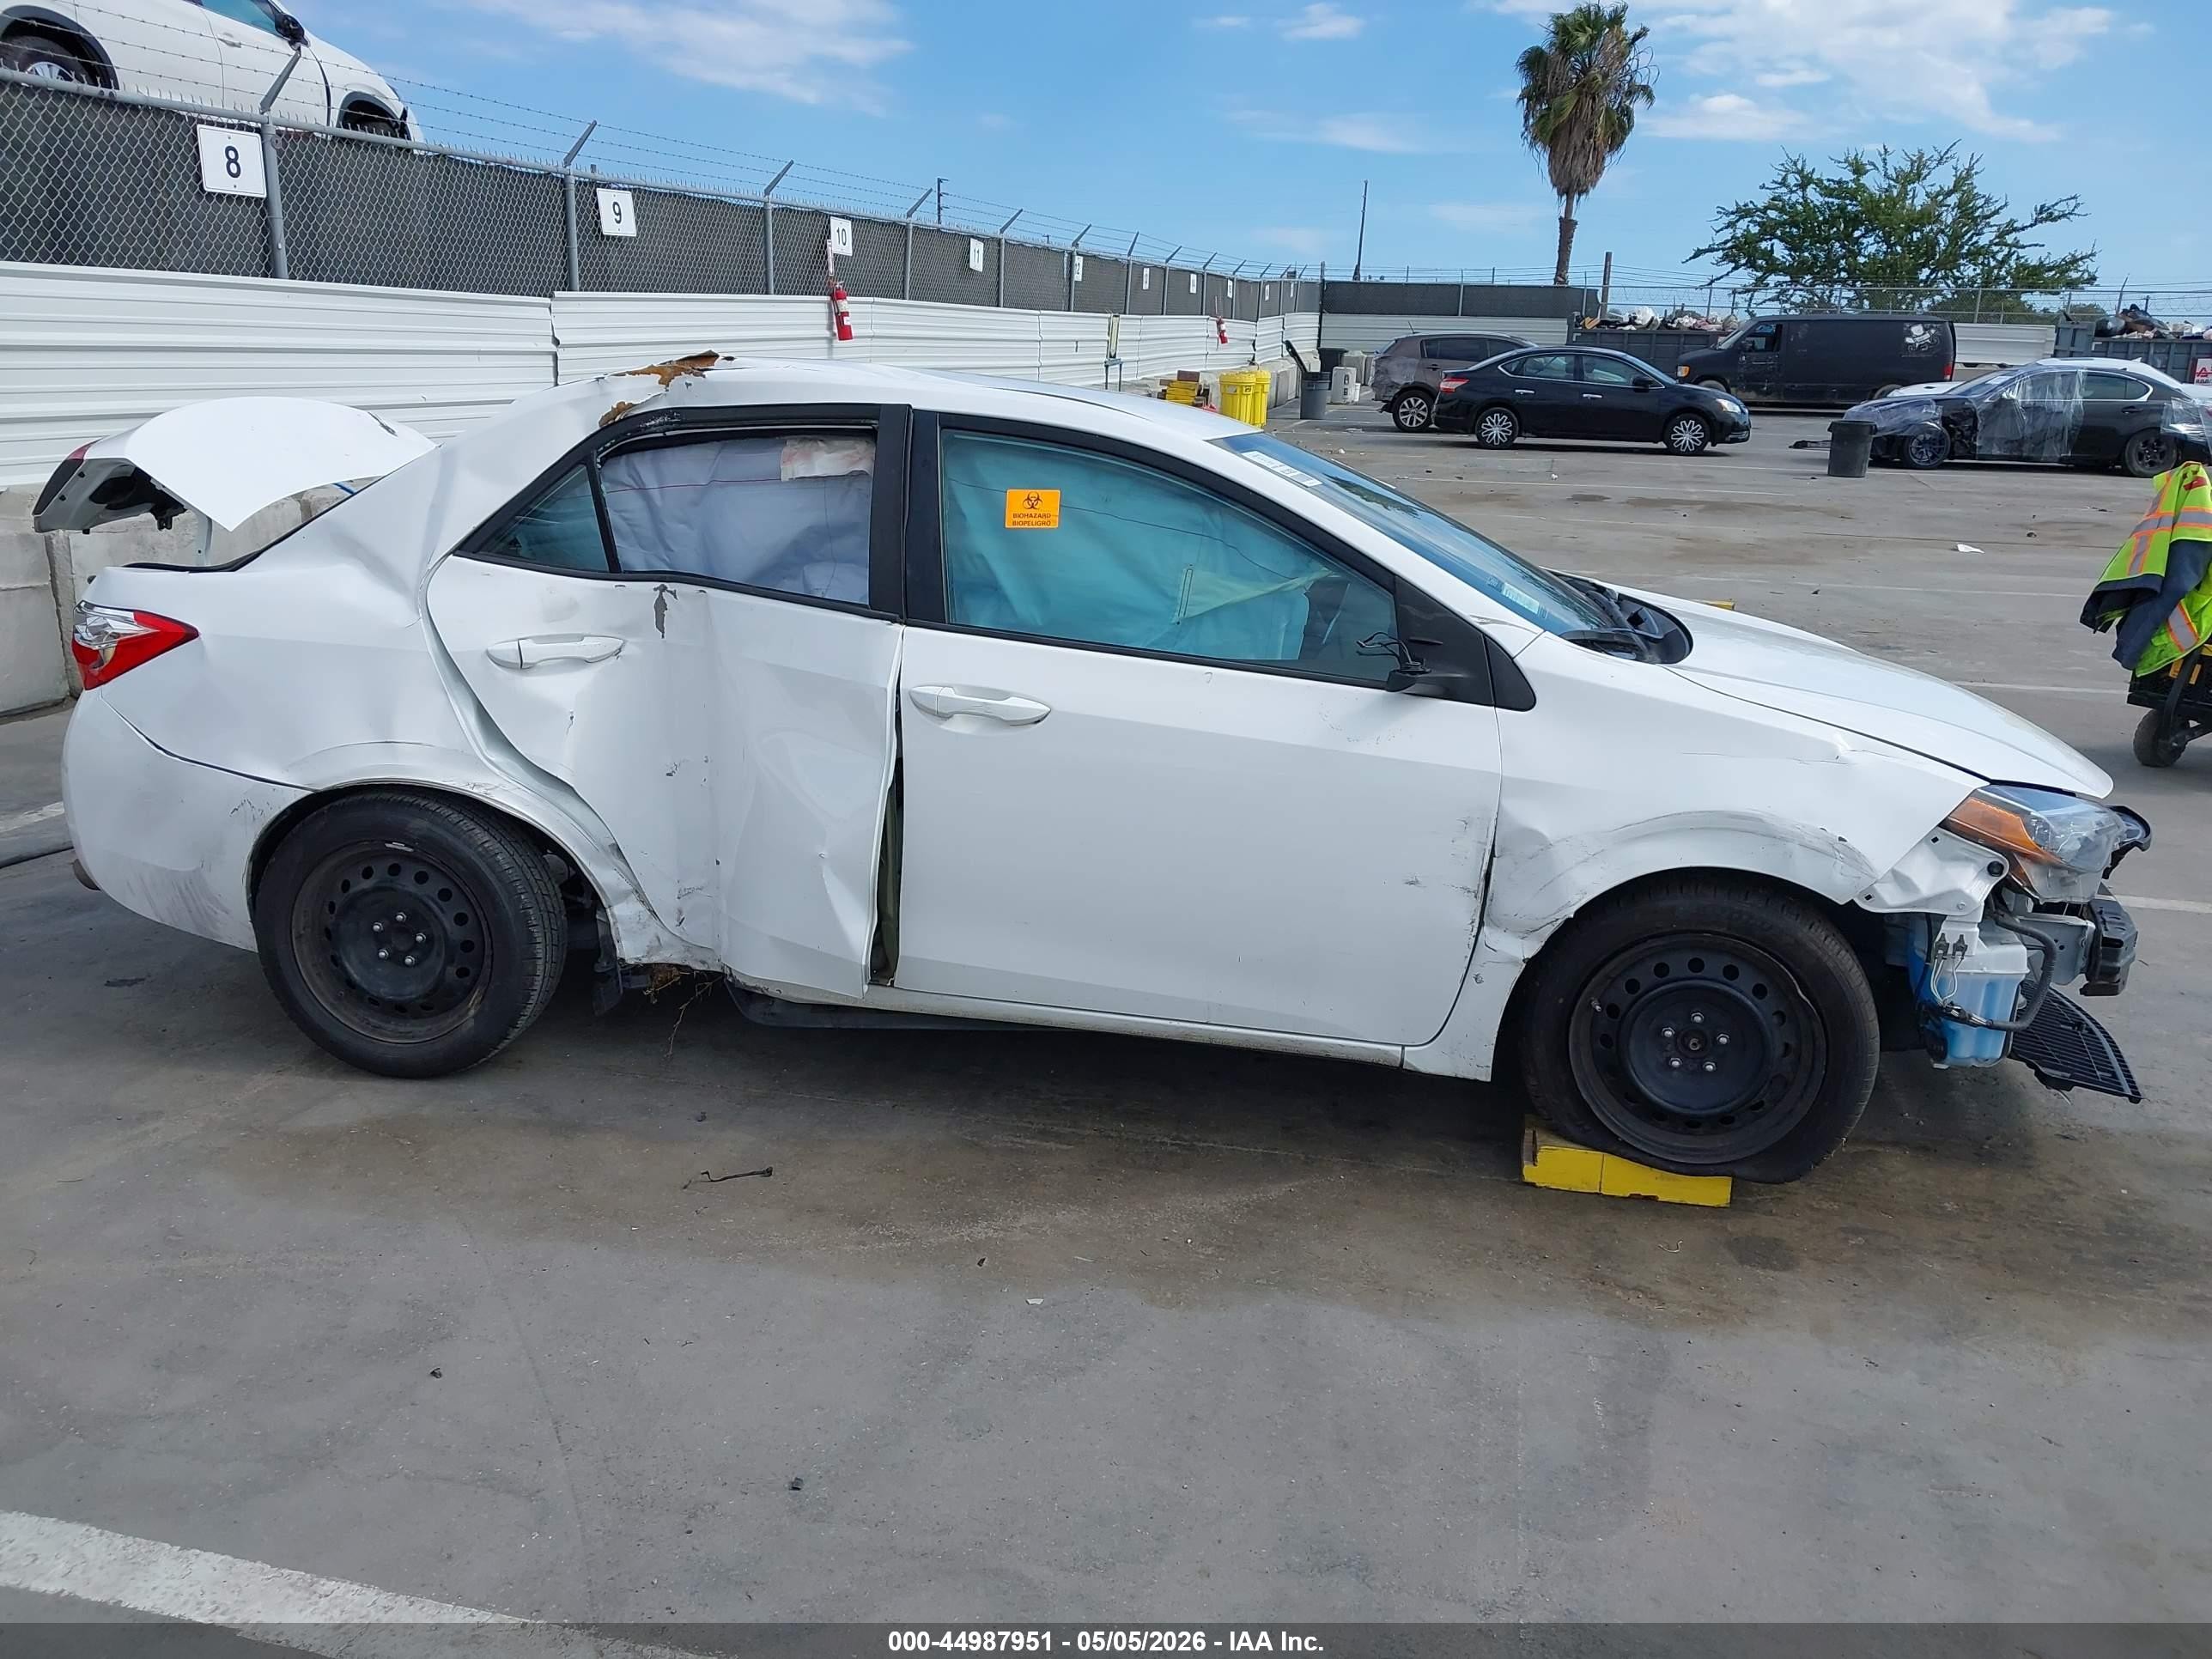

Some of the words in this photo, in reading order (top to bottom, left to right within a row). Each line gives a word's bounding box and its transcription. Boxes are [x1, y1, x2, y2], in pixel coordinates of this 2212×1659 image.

[224, 145, 241, 179] 8
[612, 201, 623, 225] 9
[836, 227, 848, 246] 10
[973, 247, 980, 264] 11
